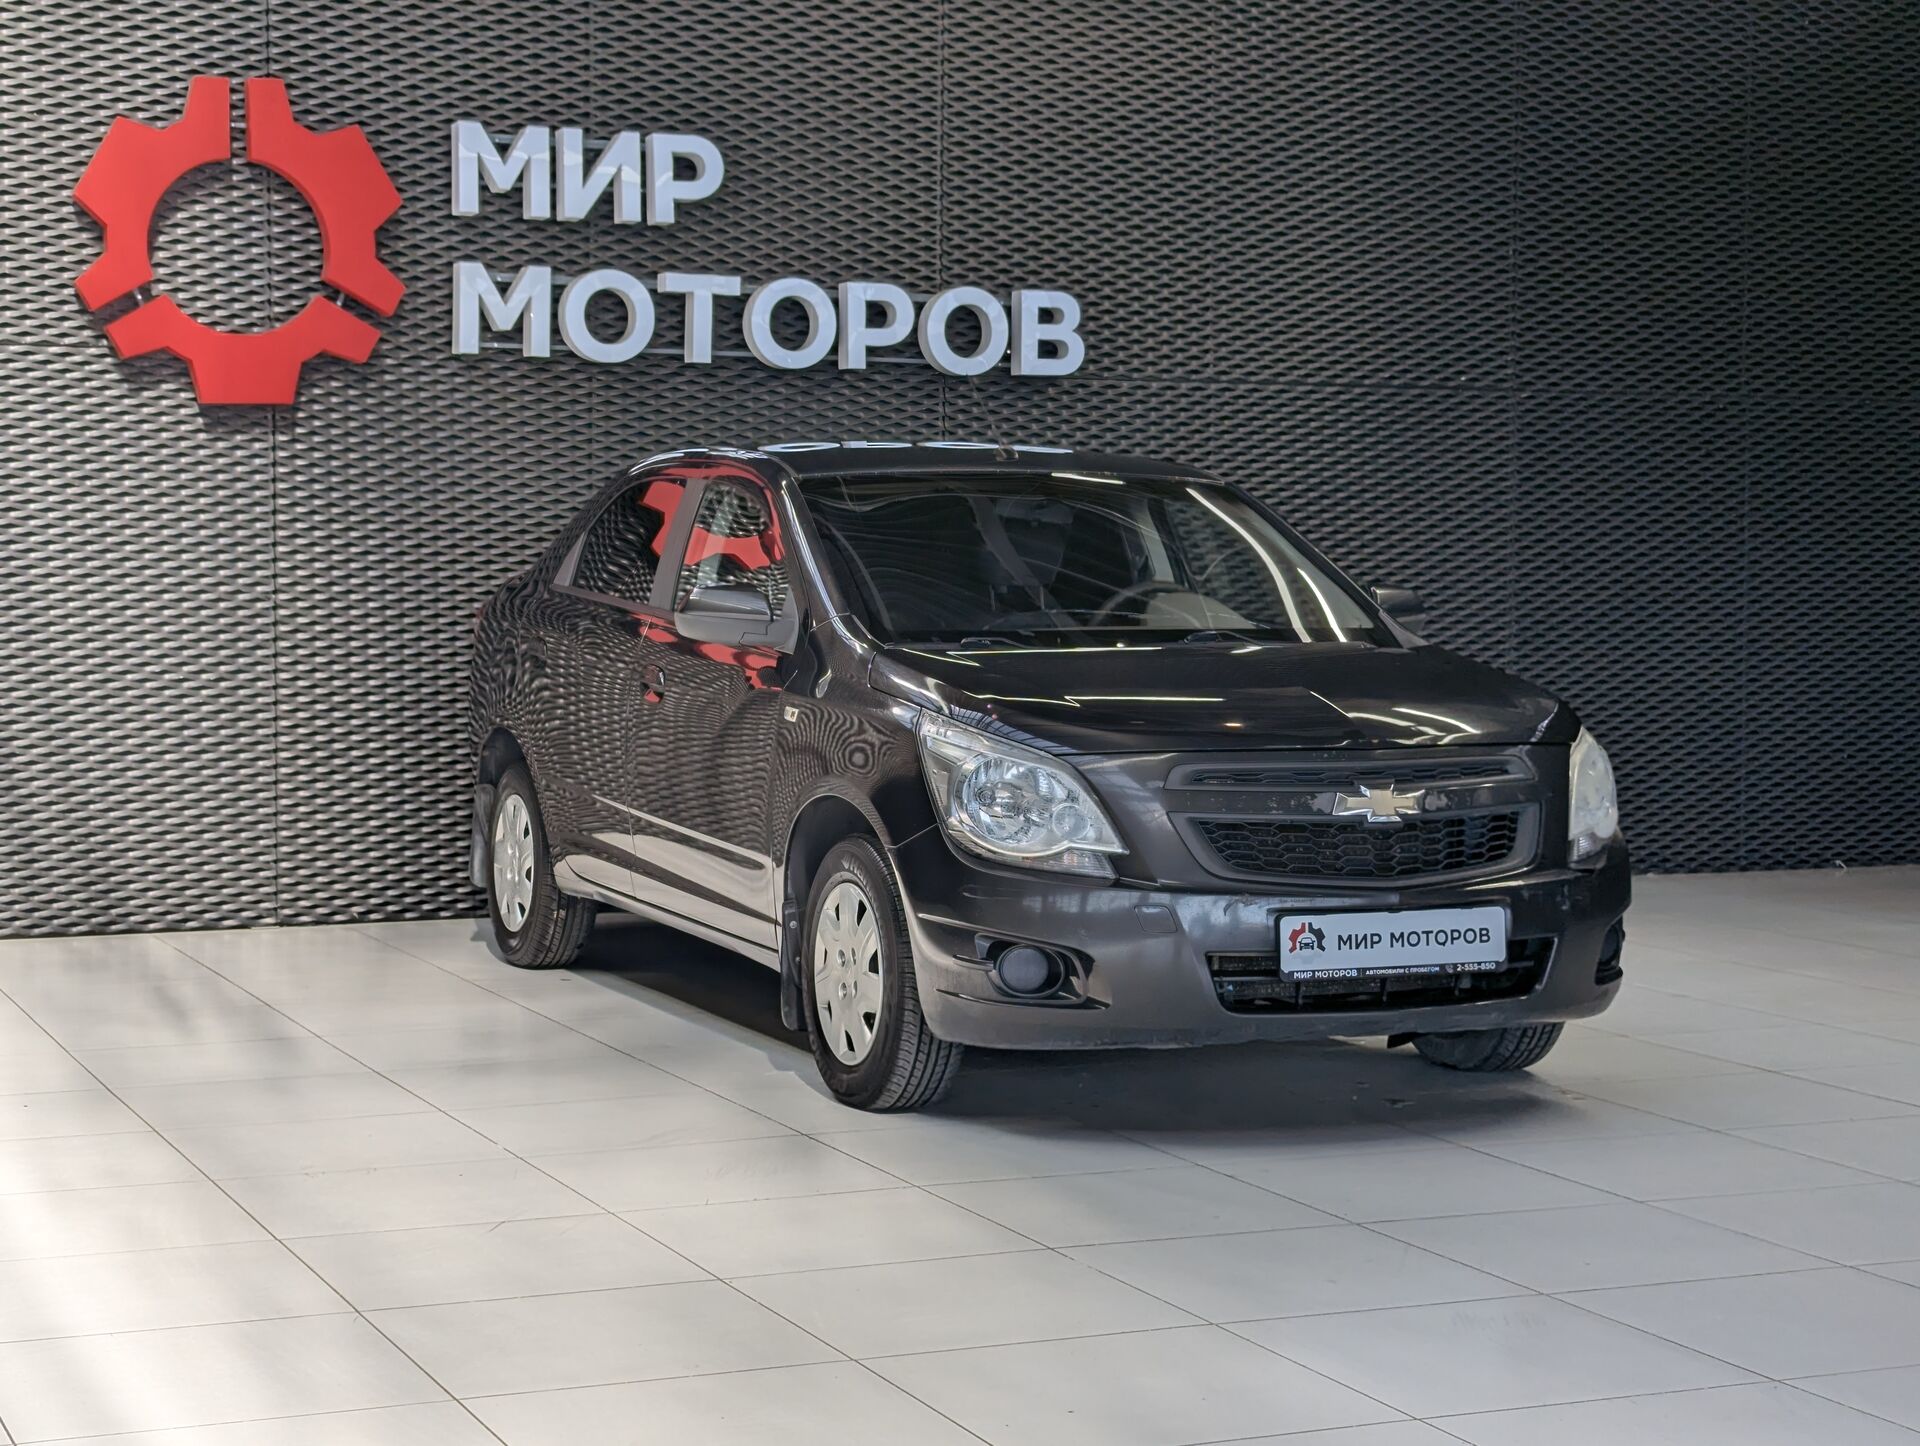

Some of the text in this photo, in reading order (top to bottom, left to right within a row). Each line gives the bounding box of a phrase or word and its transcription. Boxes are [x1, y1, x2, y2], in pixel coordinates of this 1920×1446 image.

[451, 121, 725, 226] МИР
[451, 261, 1085, 377] МОТОРОВ
[1337, 927, 1491, 951] МИР МОТОРОВ
[1293, 970, 1313, 979] МИР
[1315, 968, 1358, 978] МОТОРОВ
